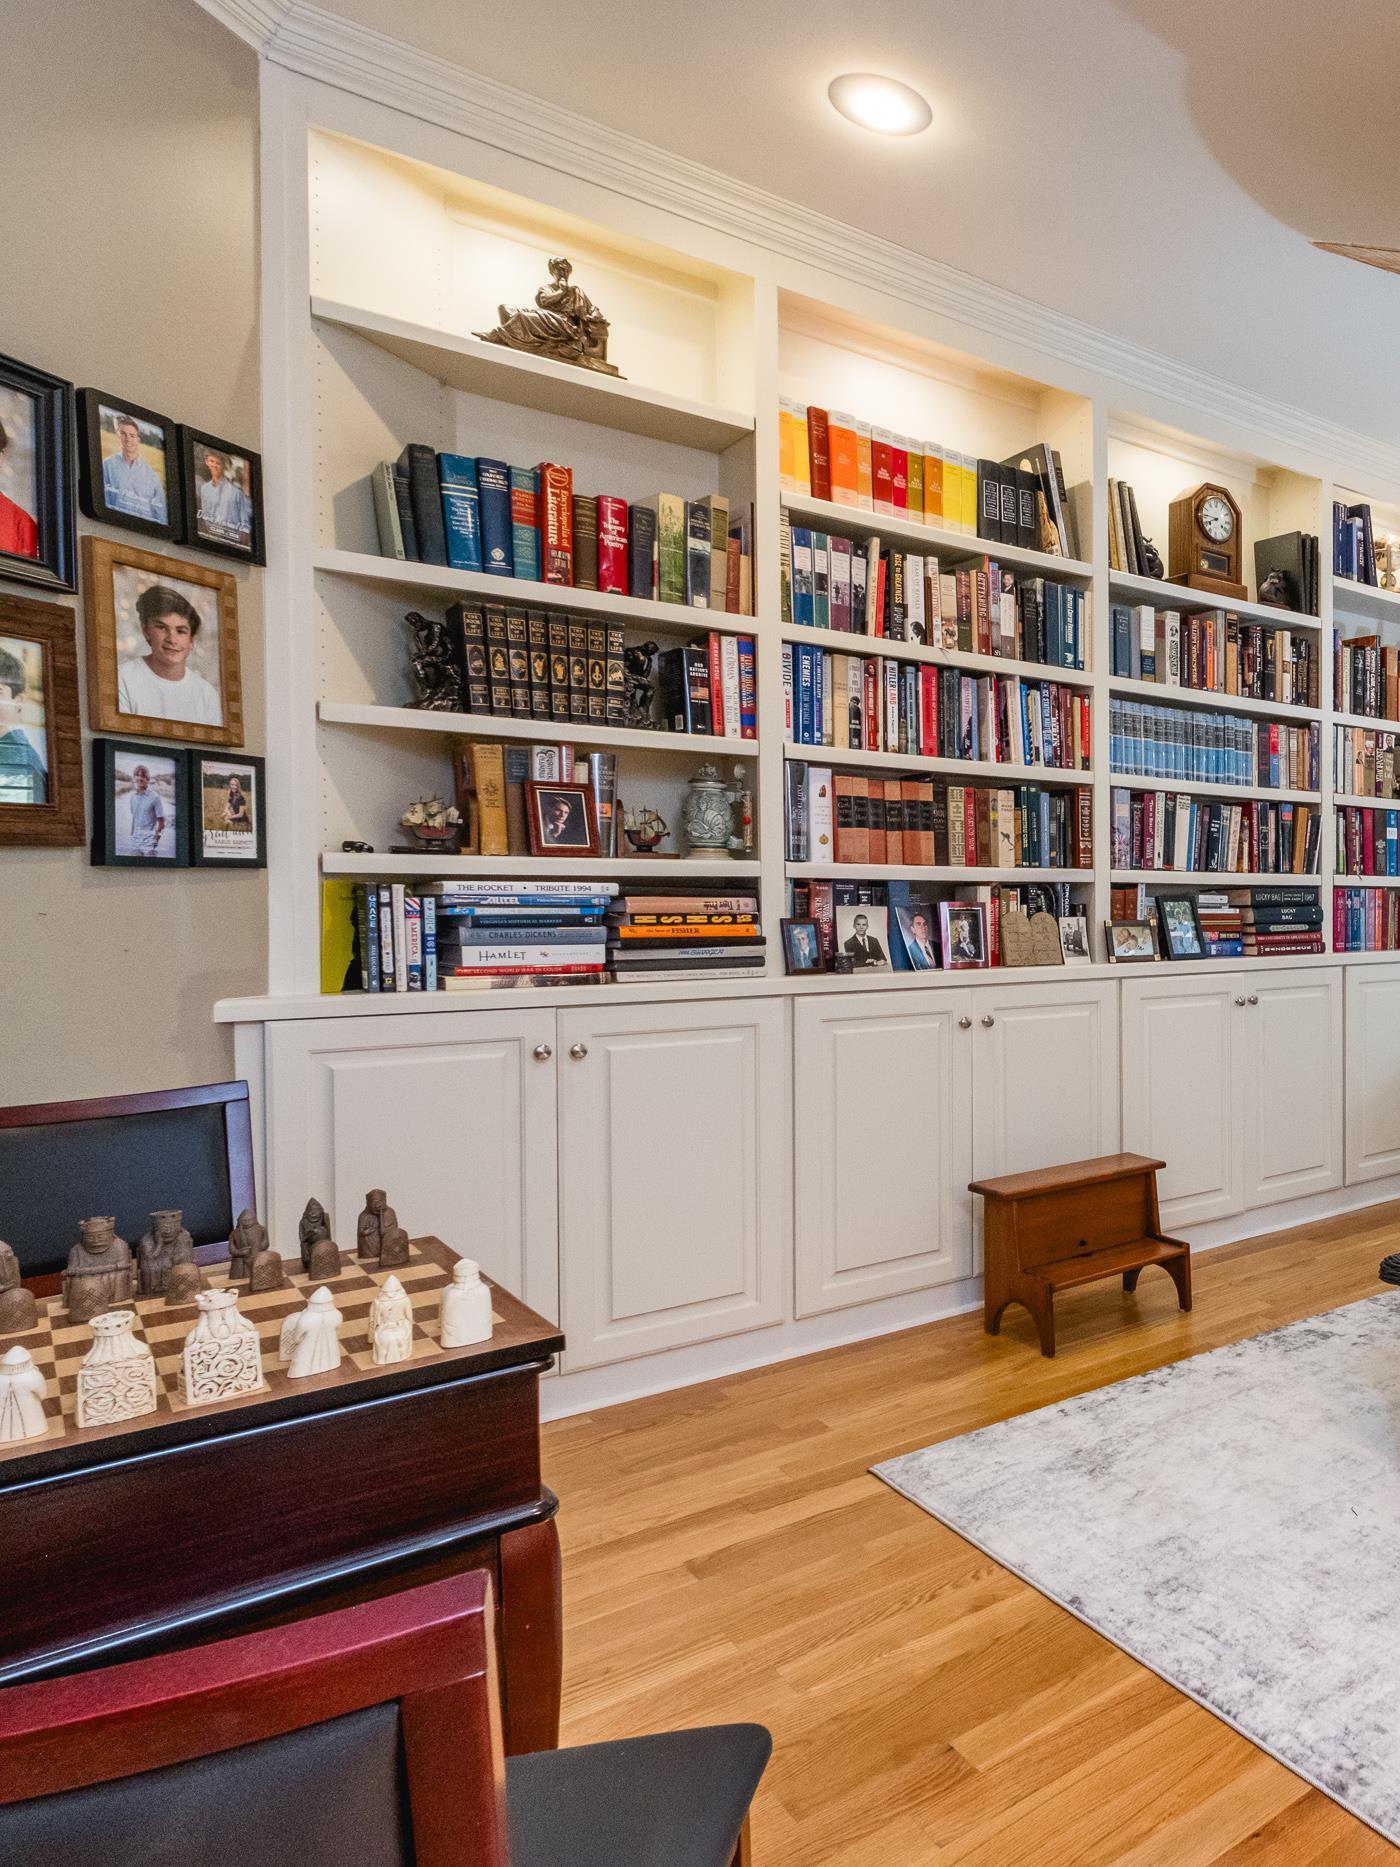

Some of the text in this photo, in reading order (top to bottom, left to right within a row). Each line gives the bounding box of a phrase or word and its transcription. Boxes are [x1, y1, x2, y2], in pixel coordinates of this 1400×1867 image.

[547, 487, 559, 545] Literature
[560, 489, 570, 548] Encyclopedia of
[599, 532, 628, 544] American
[603, 540, 624, 550] Poetry
[894, 553, 903, 567] RISE
[894, 574, 904, 604] GREATNESS
[977, 572, 987, 618] GETTYSBURG
[726, 640, 736, 680] SUZE ORMAN
[802, 656, 810, 687] ENEMIES
[744, 655, 754, 708] TOM BROKAW
[888, 666, 896, 705] HITLERLAND
[456, 884, 476, 892] THE
[478, 884, 514, 892] ROCKET
[534, 884, 570, 892] TRIBUTE
[1256, 893, 1270, 901] LUCKY
[1271, 893, 1281, 901] BAG
[368, 895, 377, 928] GRACE
[704, 900, 733, 910] Tiger Pride
[822, 904, 830, 922] WAR
[488, 932, 522, 940] CHARLES
[478, 950, 527, 962] HAMLET
